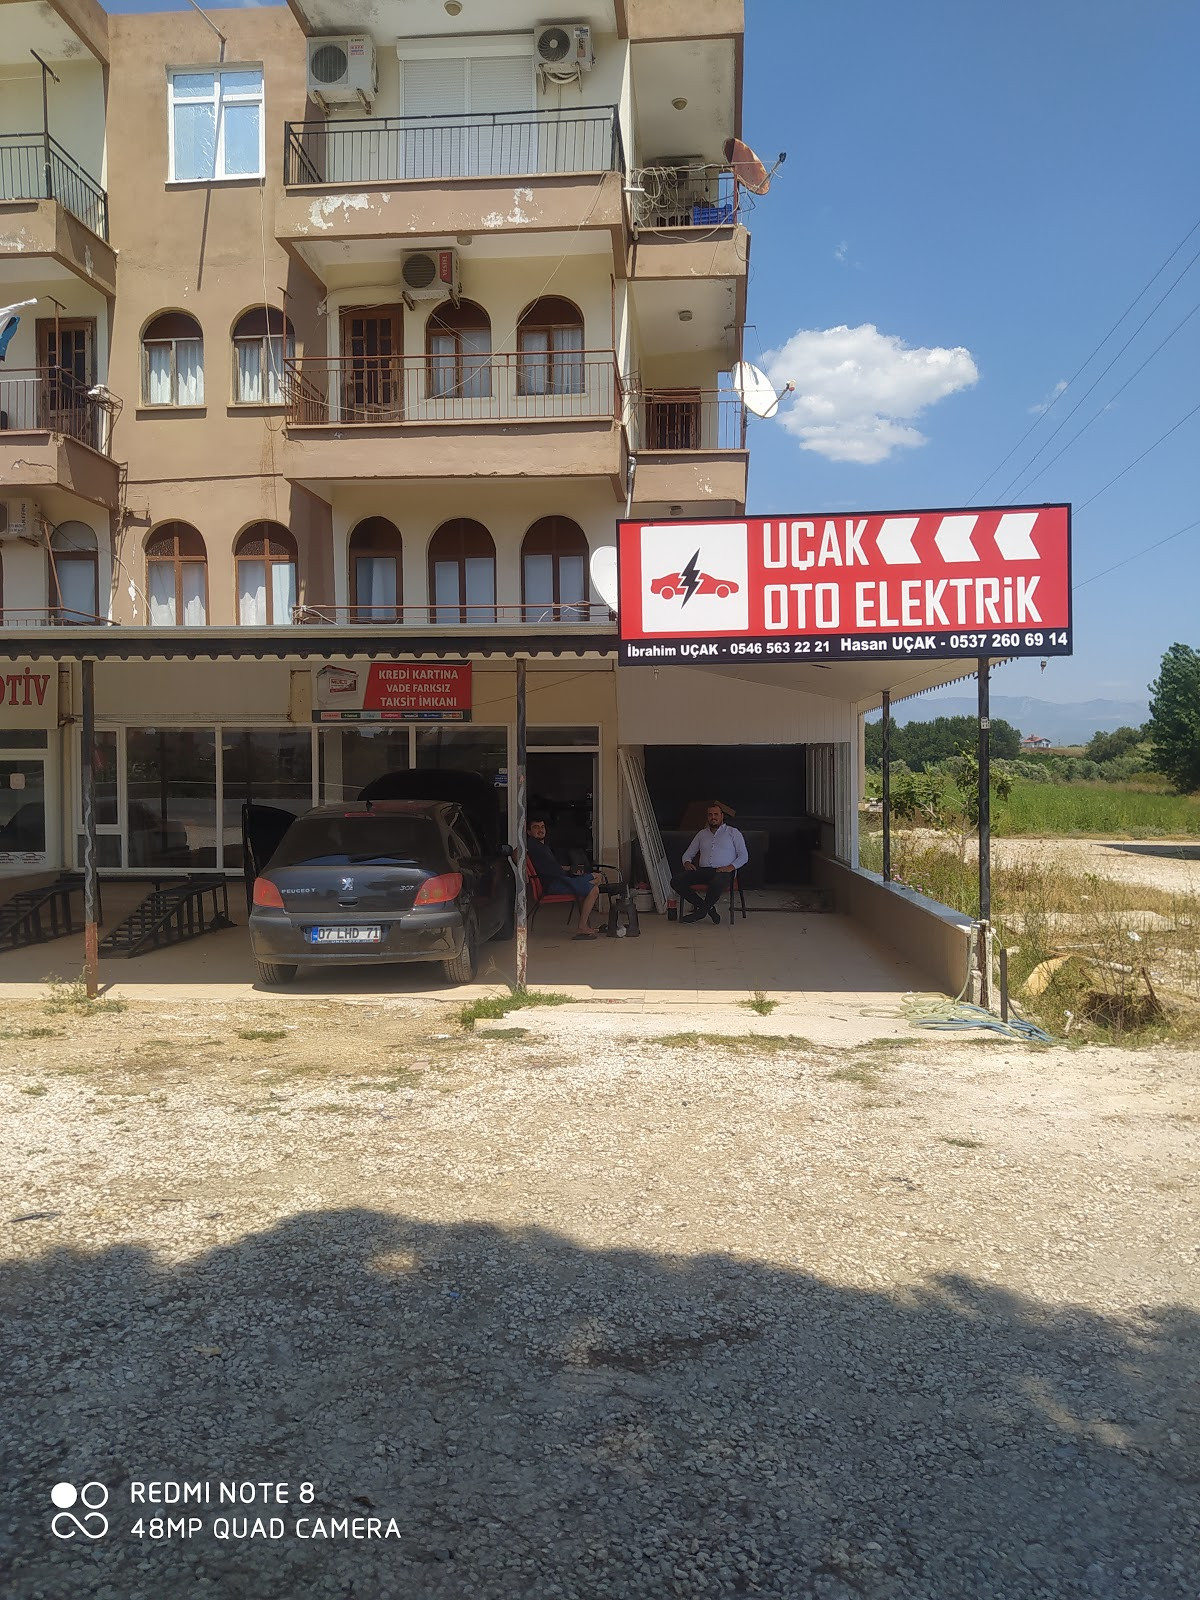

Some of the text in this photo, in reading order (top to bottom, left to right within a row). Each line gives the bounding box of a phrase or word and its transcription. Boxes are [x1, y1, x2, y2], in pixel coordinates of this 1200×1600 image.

[763, 519, 870, 571] UÇAK
[763, 582, 840, 630] OTO
[627, 643, 677, 657] İbrahim
[680, 643, 719, 658] UÇAK
[730, 642, 762, 655] 0546
[766, 641, 790, 654] 563
[794, 641, 811, 653] 22
[814, 640, 830, 653] 21
[840, 638, 887, 651] Hasan
[892, 636, 937, 653] UÇAK
[950, 634, 987, 648] 0537
[991, 633, 1020, 647] 260
[1024, 632, 1044, 646] 69
[1048, 631, 1068, 646] 14
[378, 667, 459, 680] KREDİ KARTINA
[0, 666, 51, 706] TİV
[386, 683, 451, 693] VADE FARKSIZ
[380, 695, 457, 707] TAKSİT İMKANI
[318, 927, 379, 939] 07 LHD 71
